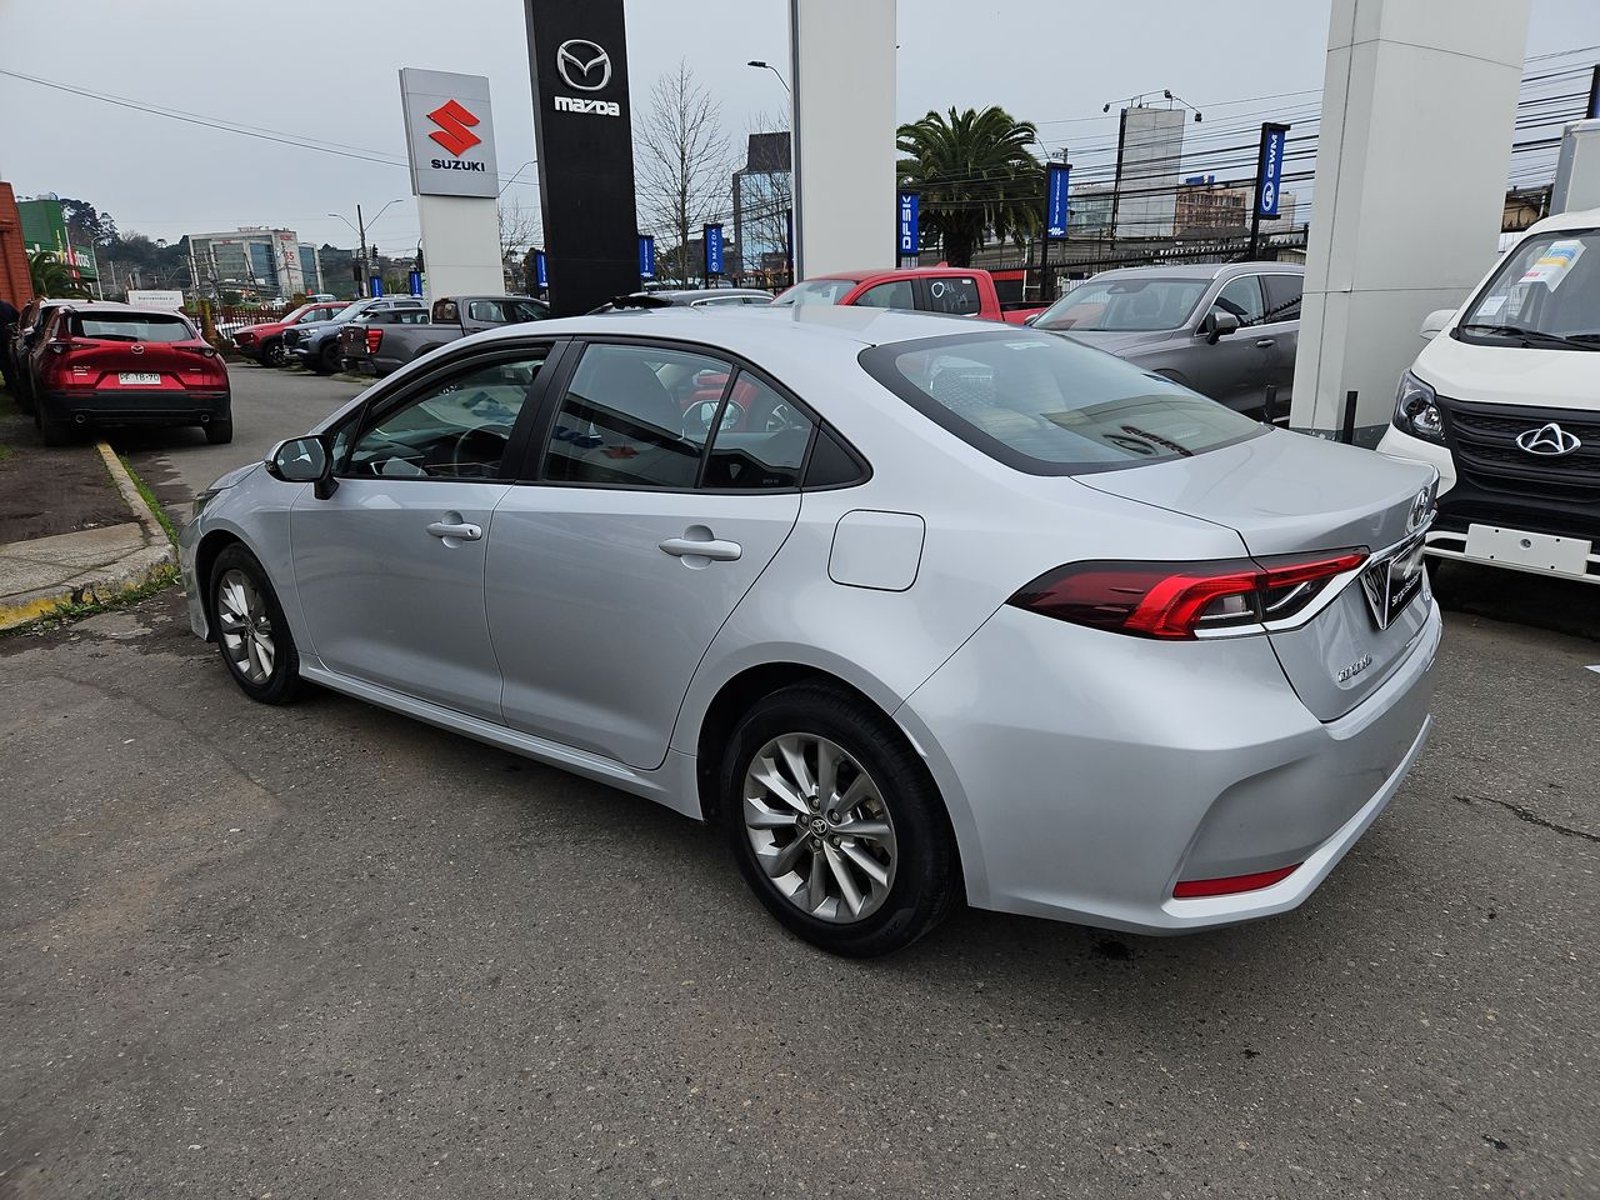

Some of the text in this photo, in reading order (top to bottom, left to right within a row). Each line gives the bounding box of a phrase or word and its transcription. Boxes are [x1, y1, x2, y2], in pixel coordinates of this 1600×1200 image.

[554, 96, 621, 117] mazda
[431, 159, 485, 172] SUZUKI
[1267, 134, 1278, 178] GWM
[902, 196, 911, 249] DFSK
